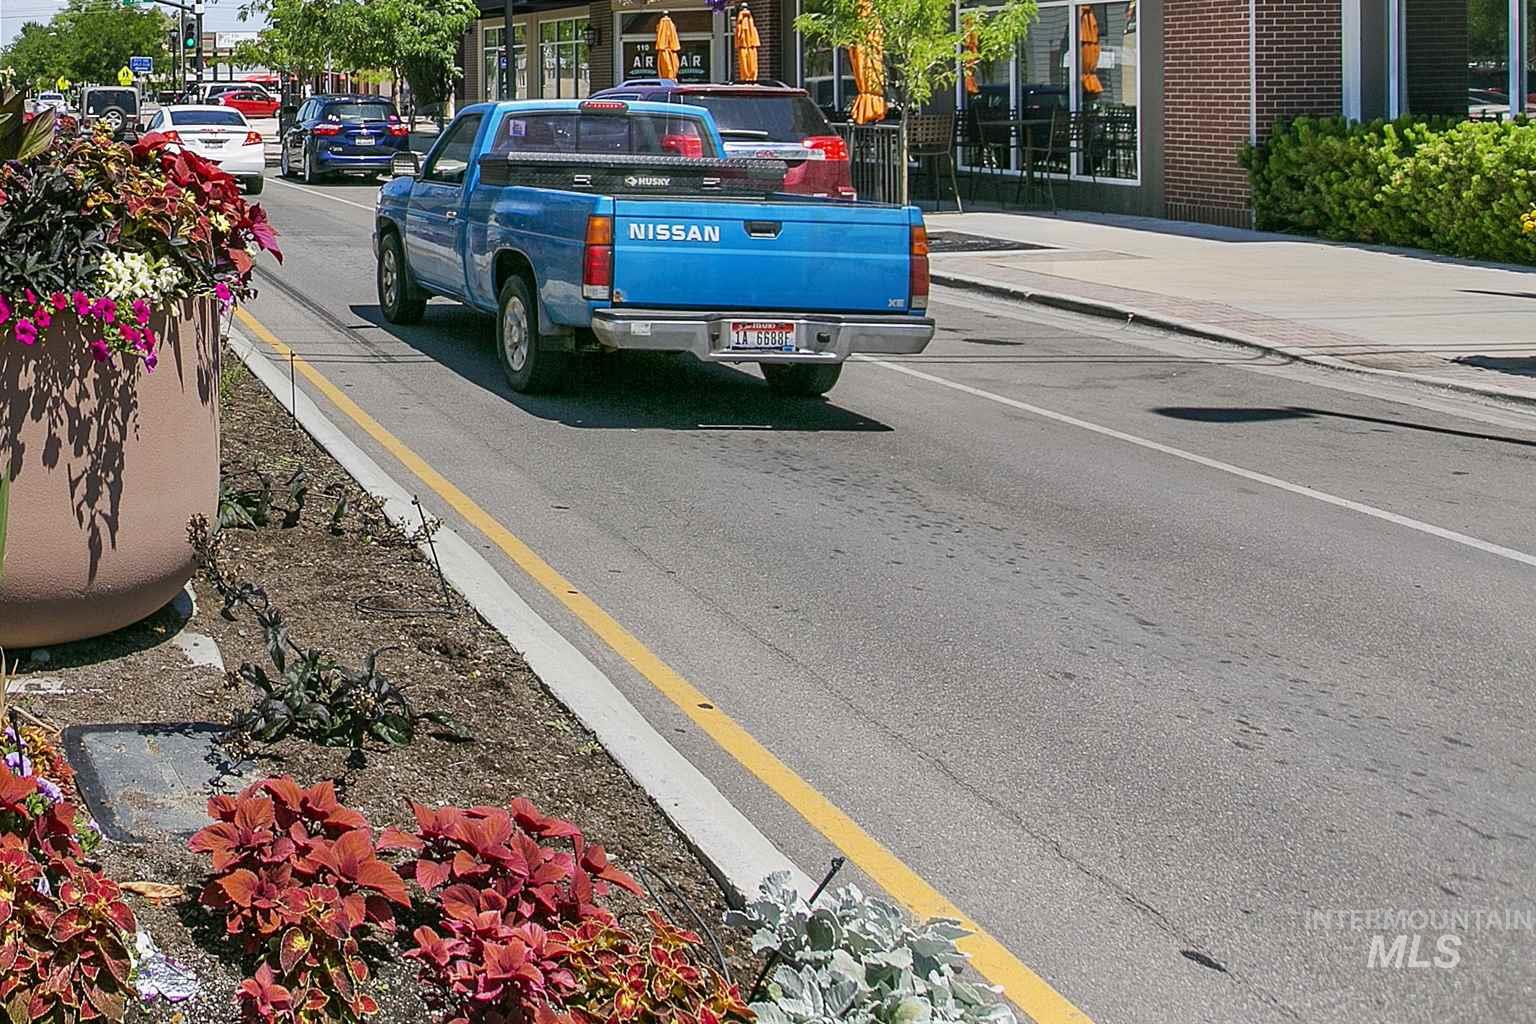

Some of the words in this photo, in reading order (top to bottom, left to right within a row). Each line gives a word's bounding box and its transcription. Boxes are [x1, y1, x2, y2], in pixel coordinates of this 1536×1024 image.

[638, 177, 671, 185] HUSKY
[629, 223, 720, 242] NISSAN
[735, 331, 748, 345] 1A
